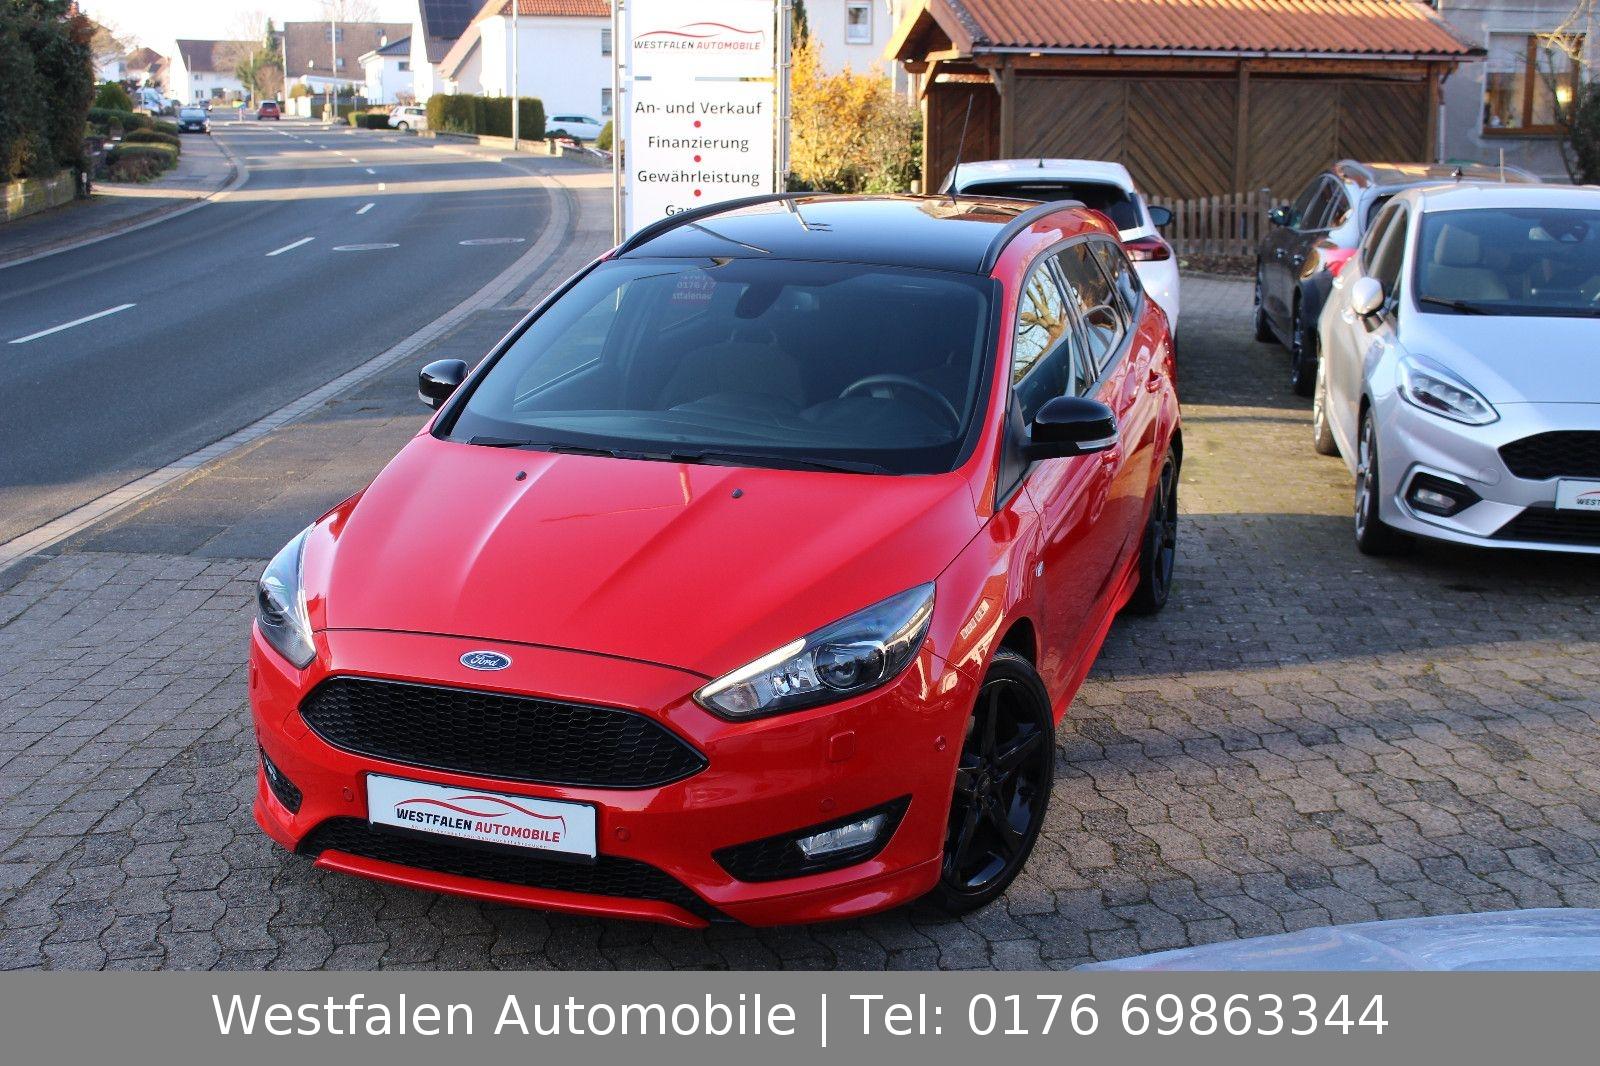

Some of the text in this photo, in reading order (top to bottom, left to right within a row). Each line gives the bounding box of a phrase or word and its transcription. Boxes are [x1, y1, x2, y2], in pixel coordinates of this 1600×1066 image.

[634, 40, 761, 50] WESTFALEN AUTOMOBILE
[635, 101, 763, 115] An- und Verkauf
[648, 136, 749, 152] Finanzierung
[637, 170, 760, 187] Gewährleistung
[470, 654, 500, 667] Ford
[396, 808, 473, 831] WESTFALEN
[475, 821, 561, 843] AUTOMOBILE
